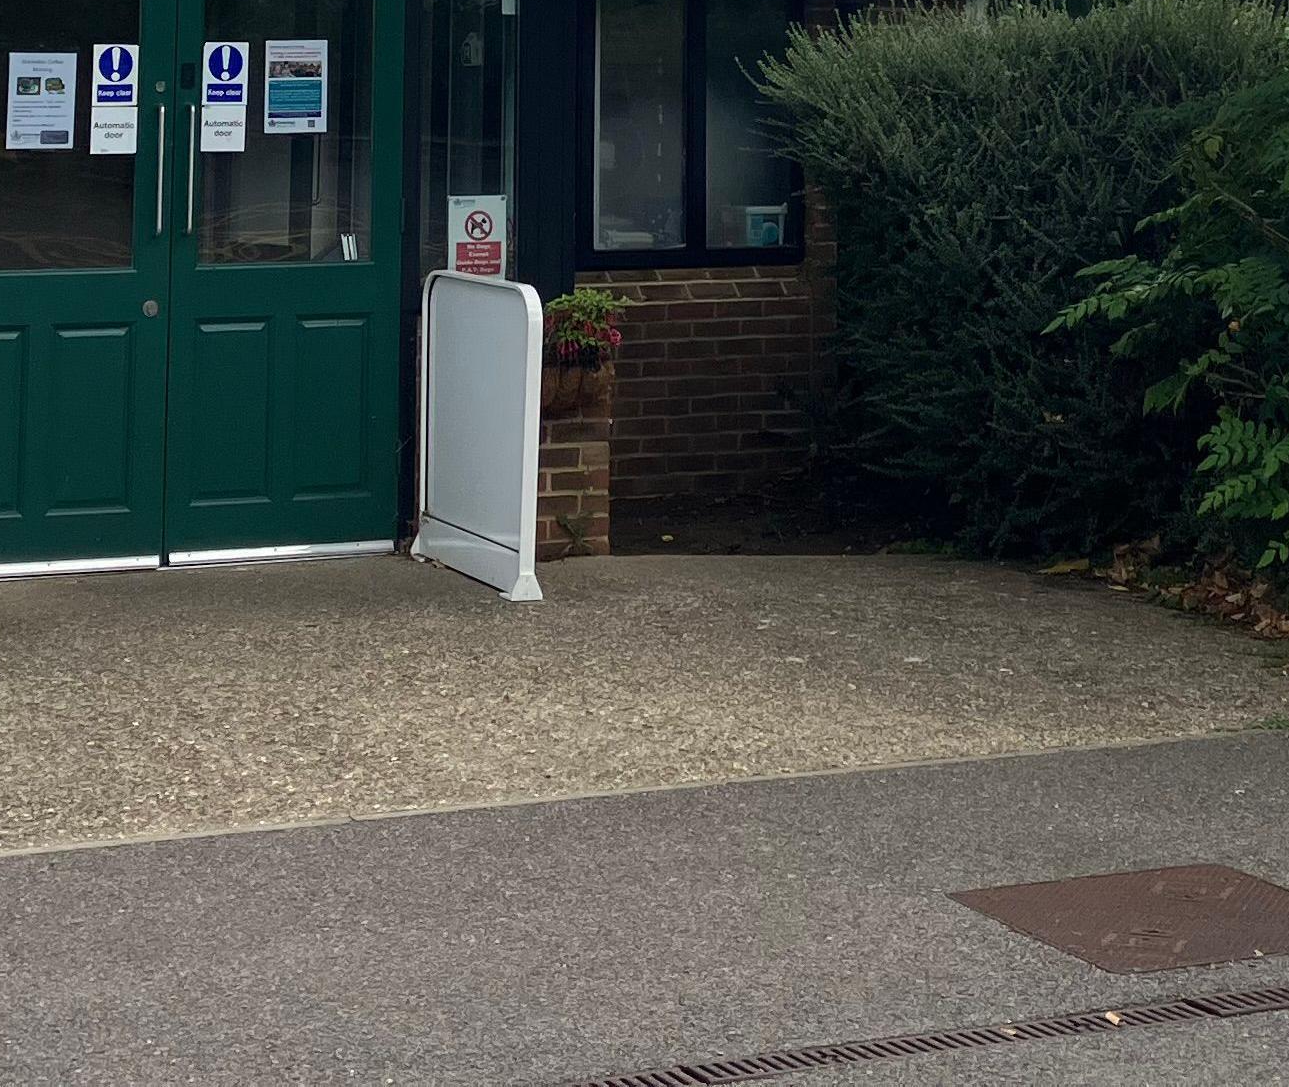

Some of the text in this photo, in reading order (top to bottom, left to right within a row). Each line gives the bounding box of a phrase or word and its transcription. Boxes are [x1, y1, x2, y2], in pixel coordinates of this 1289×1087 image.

[98, 89, 132, 98] Keep clear
[207, 88, 225, 97] Keep
[93, 121, 135, 130] Automatic
[204, 120, 244, 128] Automatic
[103, 131, 124, 139] door
